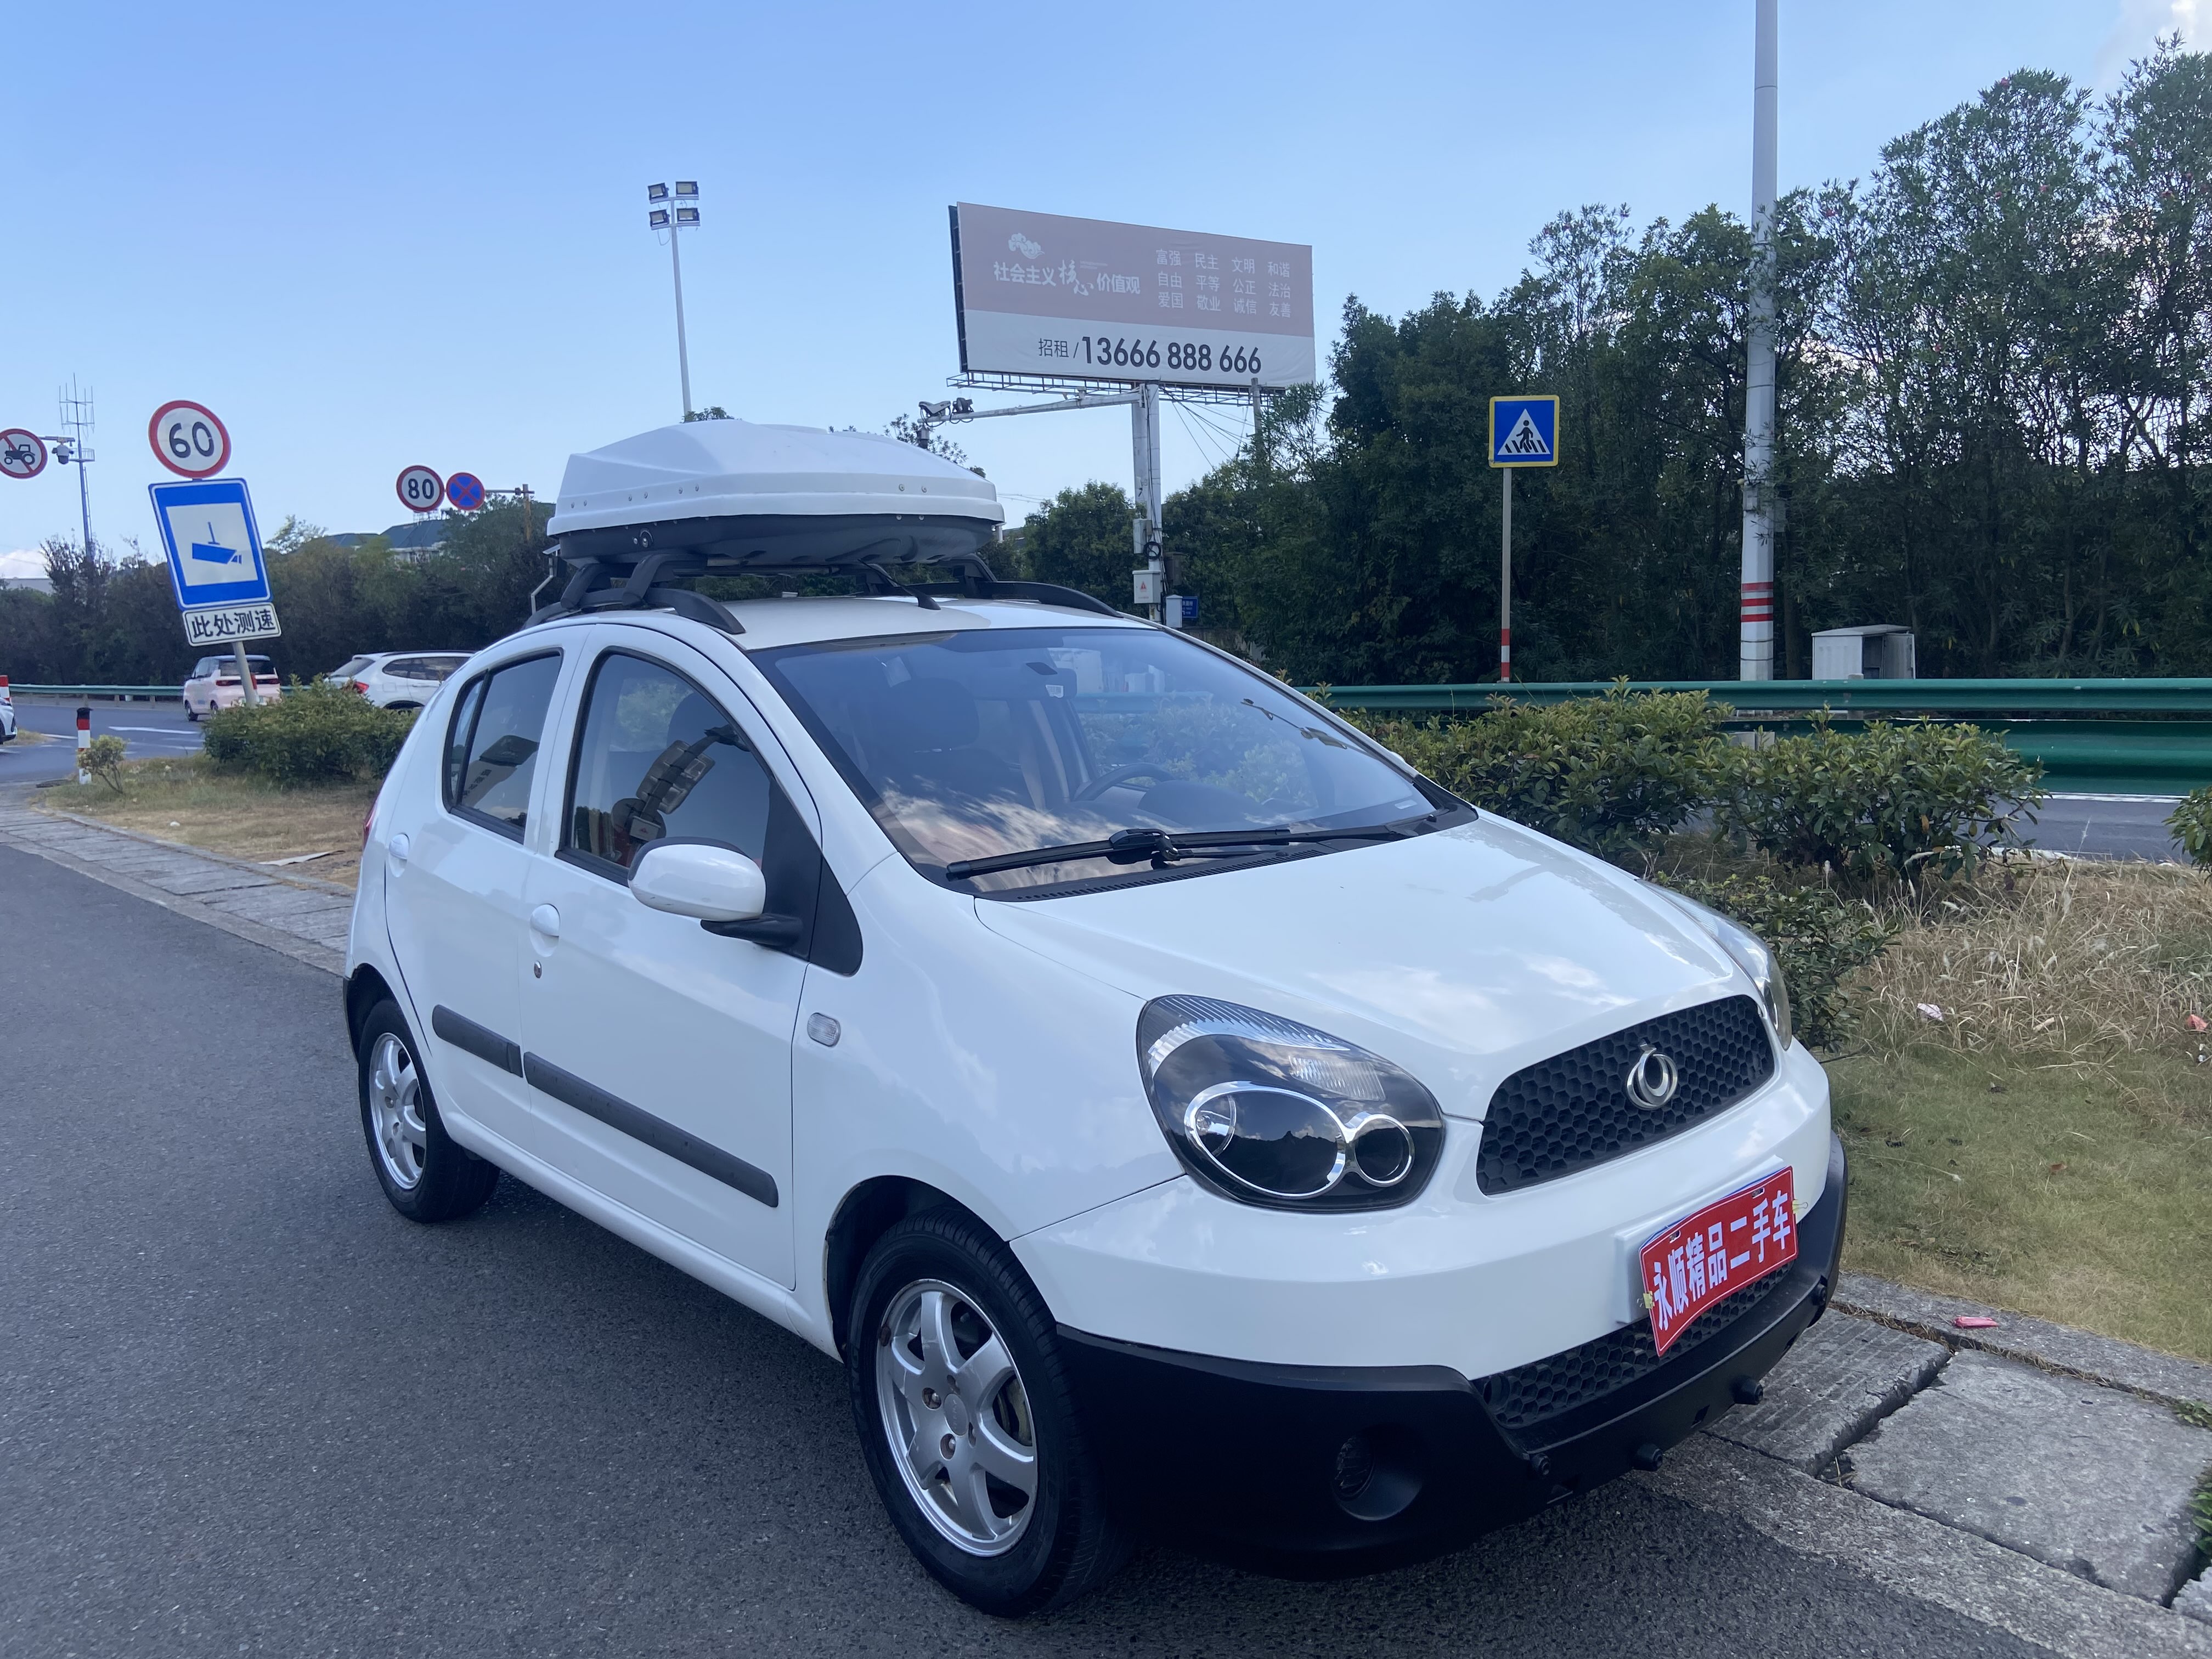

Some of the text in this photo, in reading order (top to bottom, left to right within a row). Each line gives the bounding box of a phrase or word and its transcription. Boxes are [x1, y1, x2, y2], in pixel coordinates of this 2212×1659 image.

[1156, 249, 1290, 278] 富强 民主 文明 和谐
[1158, 270, 1291, 299] 自由 平等 公正 法治
[1158, 291, 1292, 318] 爱国 敬业 诚信 友善
[1167, 342, 1212, 371] 888
[1220, 345, 1262, 374] 666
[169, 421, 215, 459] 60
[408, 478, 435, 500] 80
[190, 607, 276, 639] 此处测速
[1653, 1189, 1791, 1331] 永顺精品二手车
